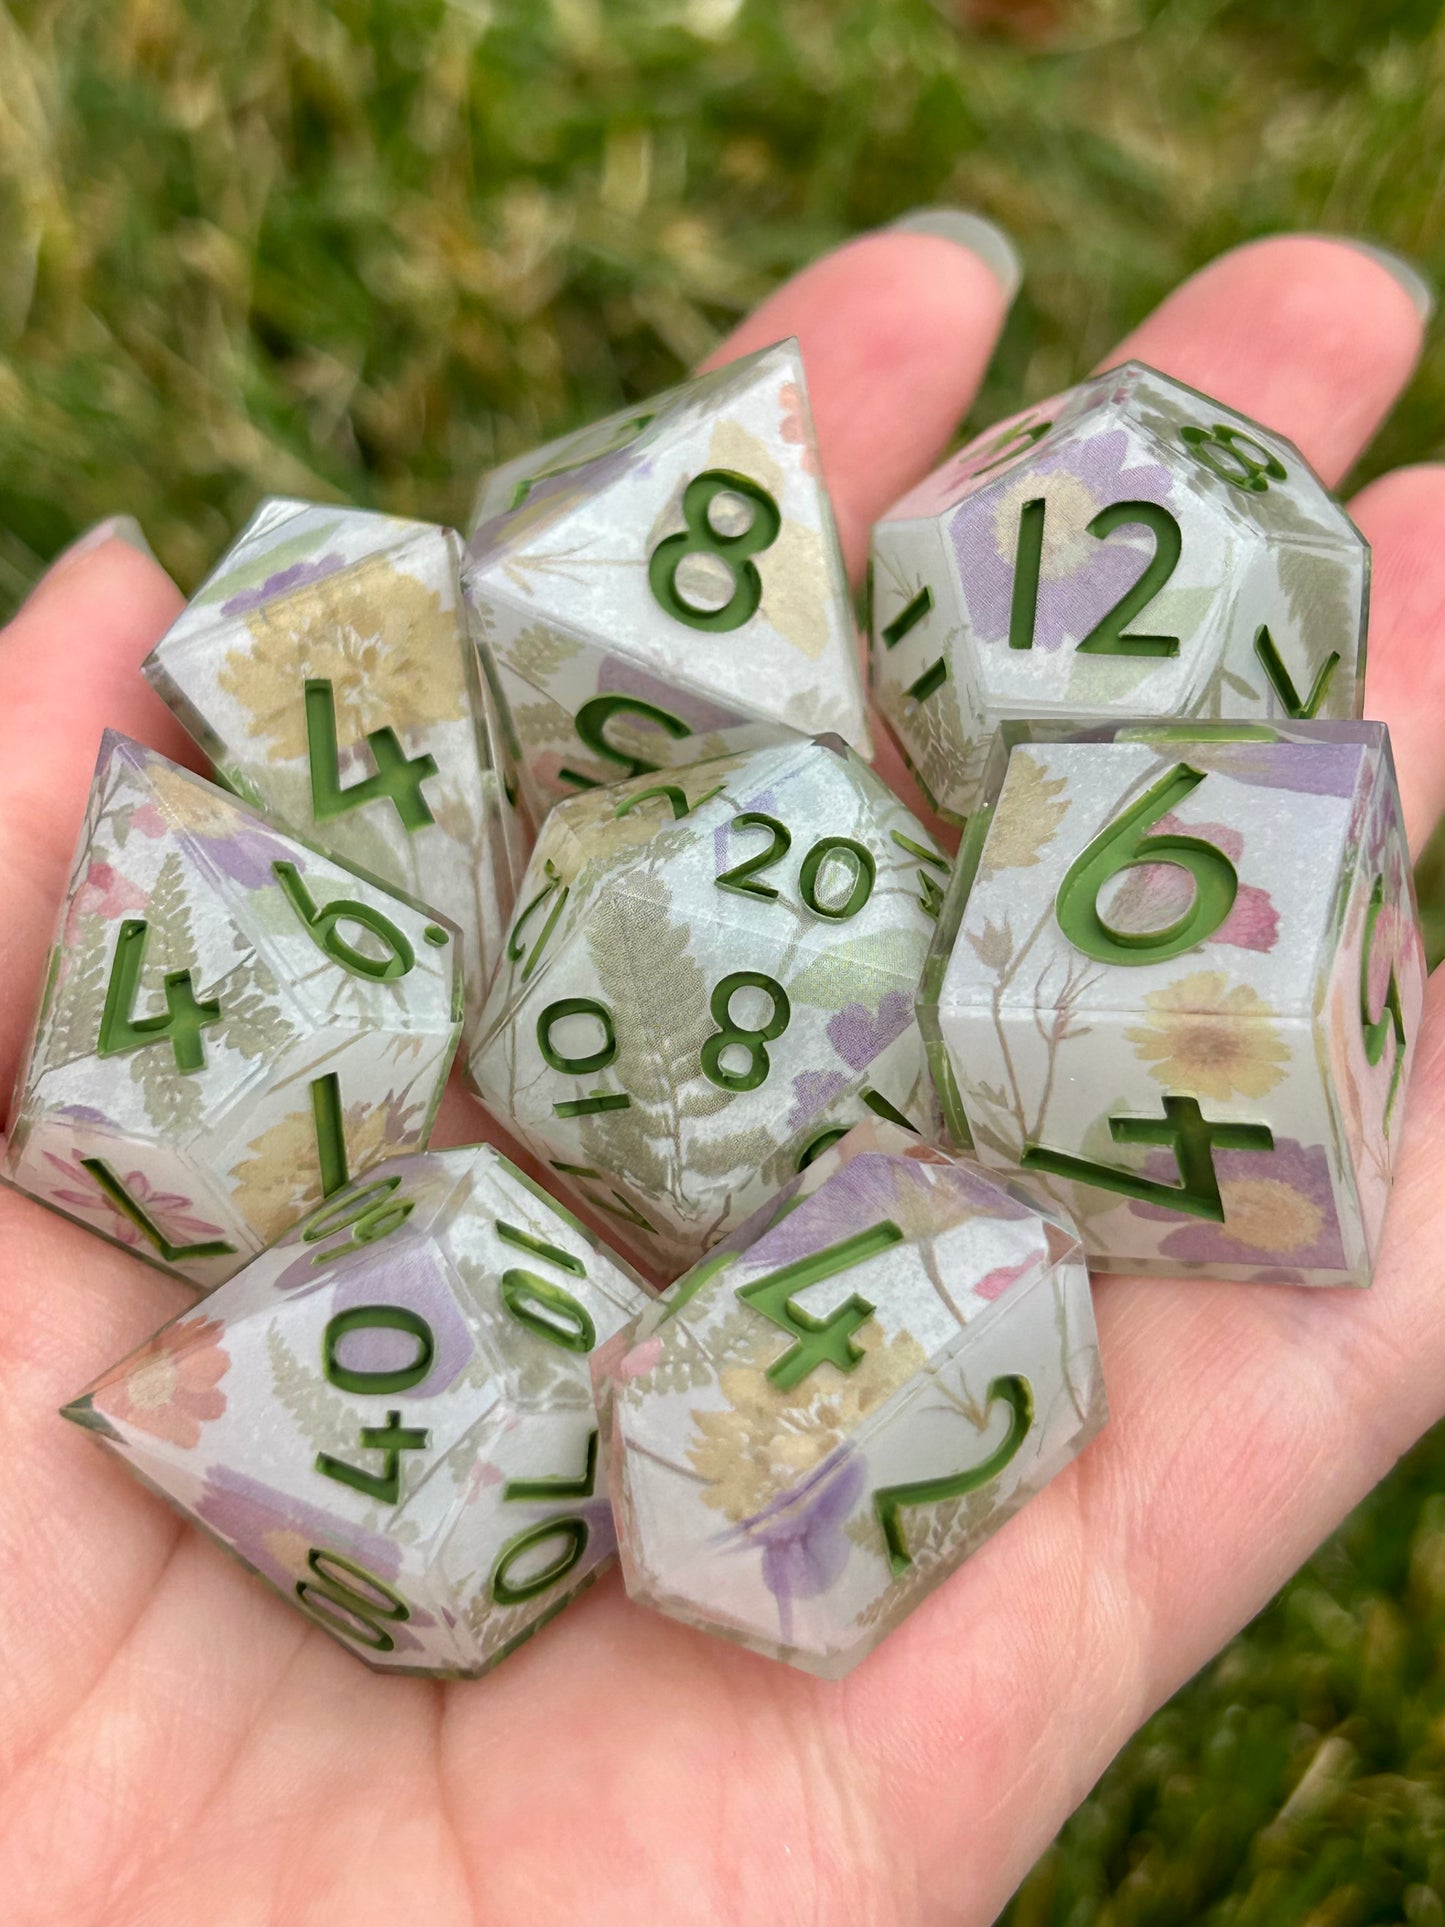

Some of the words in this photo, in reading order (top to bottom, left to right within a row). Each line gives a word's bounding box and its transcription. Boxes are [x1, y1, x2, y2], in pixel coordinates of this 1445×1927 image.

[1180, 423, 1288, 493] 8
[649, 468, 782, 634] 8
[1008, 497, 1183, 659] 12
[304, 678, 440, 832] 4
[713, 811, 878, 925] 20
[1055, 762, 1240, 967] 6
[98, 919, 222, 1076] 4
[536, 996, 631, 1119] 10
[699, 970, 792, 1093] 8
[310, 1071, 350, 1200] 1
[1019, 1095, 1276, 1224] 4
[494, 1218, 598, 1353] 10
[734, 1218, 905, 1393] 4
[312, 1304, 435, 1506] 40
[870, 1373, 1035, 1580] 2
[492, 1430, 600, 1606] 70
